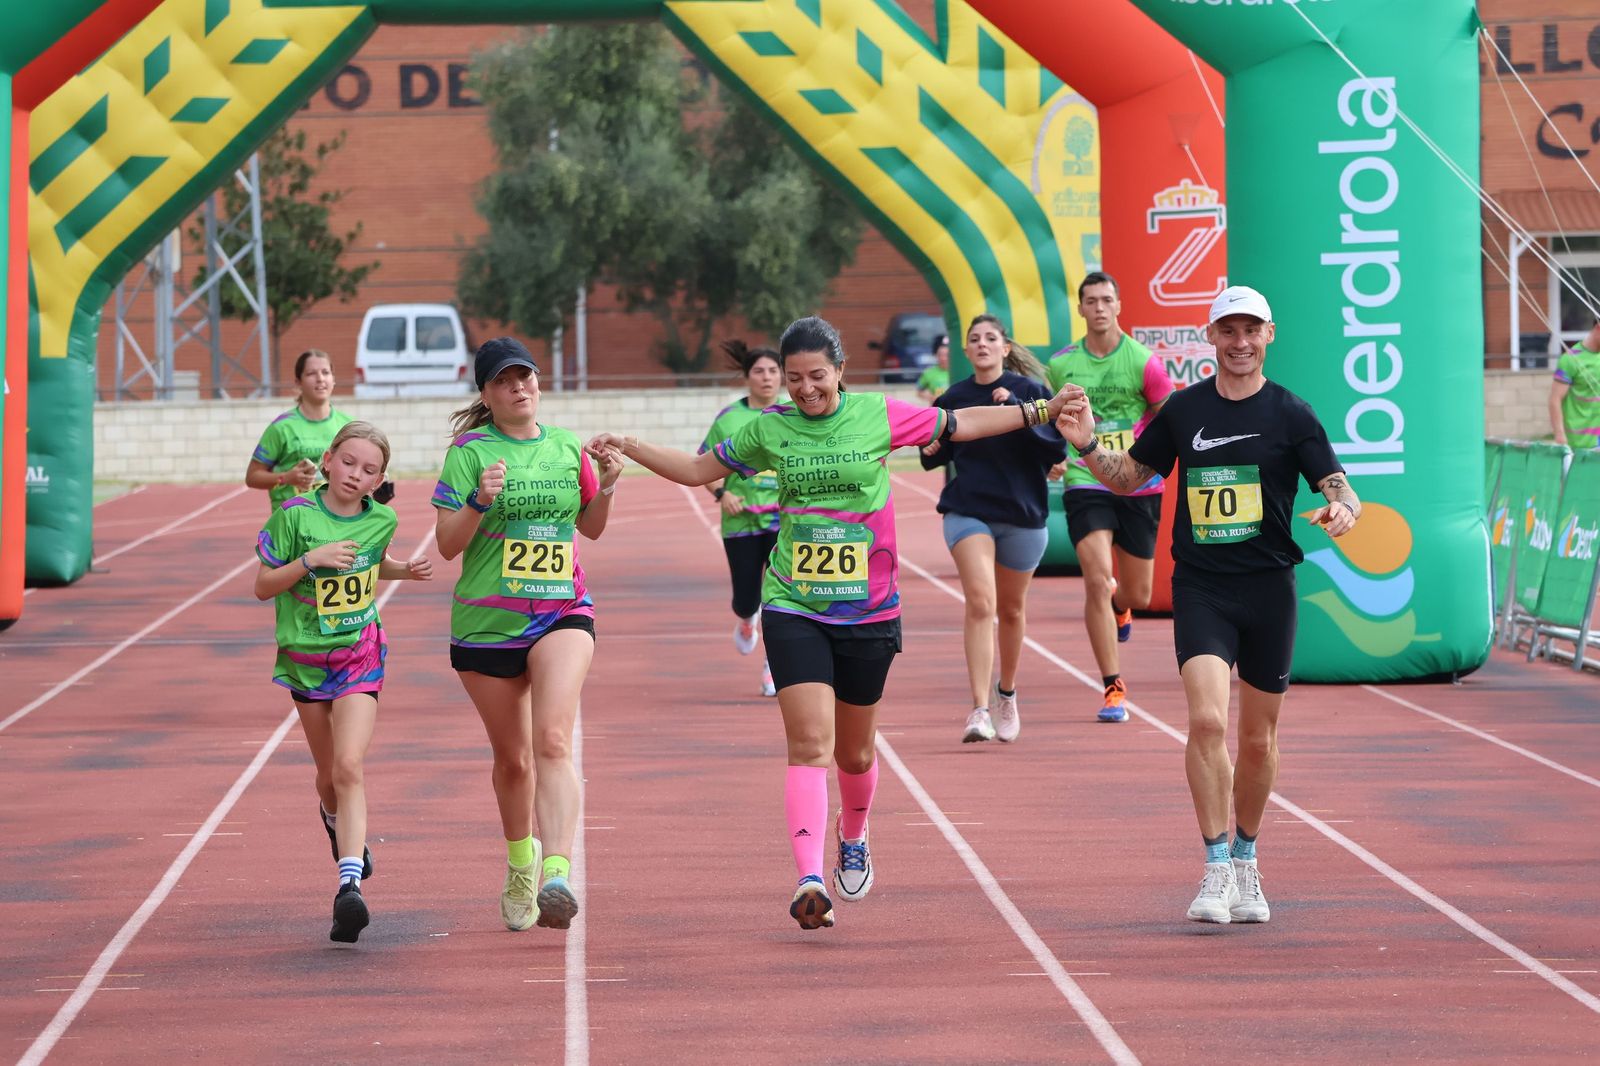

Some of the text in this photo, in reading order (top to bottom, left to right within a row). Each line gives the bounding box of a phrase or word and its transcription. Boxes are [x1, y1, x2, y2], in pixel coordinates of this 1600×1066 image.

[1318, 76, 1405, 475] Iberdrola
[786, 449, 870, 468] En marcha
[787, 468, 840, 483] contra
[507, 477, 579, 492] En marcha
[791, 482, 863, 497] el cáncer
[507, 493, 557, 507] contra
[1199, 488, 1237, 518] 70
[507, 507, 573, 521] el cáncer
[1209, 525, 1257, 538] CAJA RURAL
[508, 542, 564, 574] 225
[797, 544, 857, 575] 226
[321, 570, 372, 608] 294
[524, 584, 571, 594] CAJA RURAL
[812, 586, 865, 595] CAJA RURAL
[342, 617, 363, 626] CAJA
